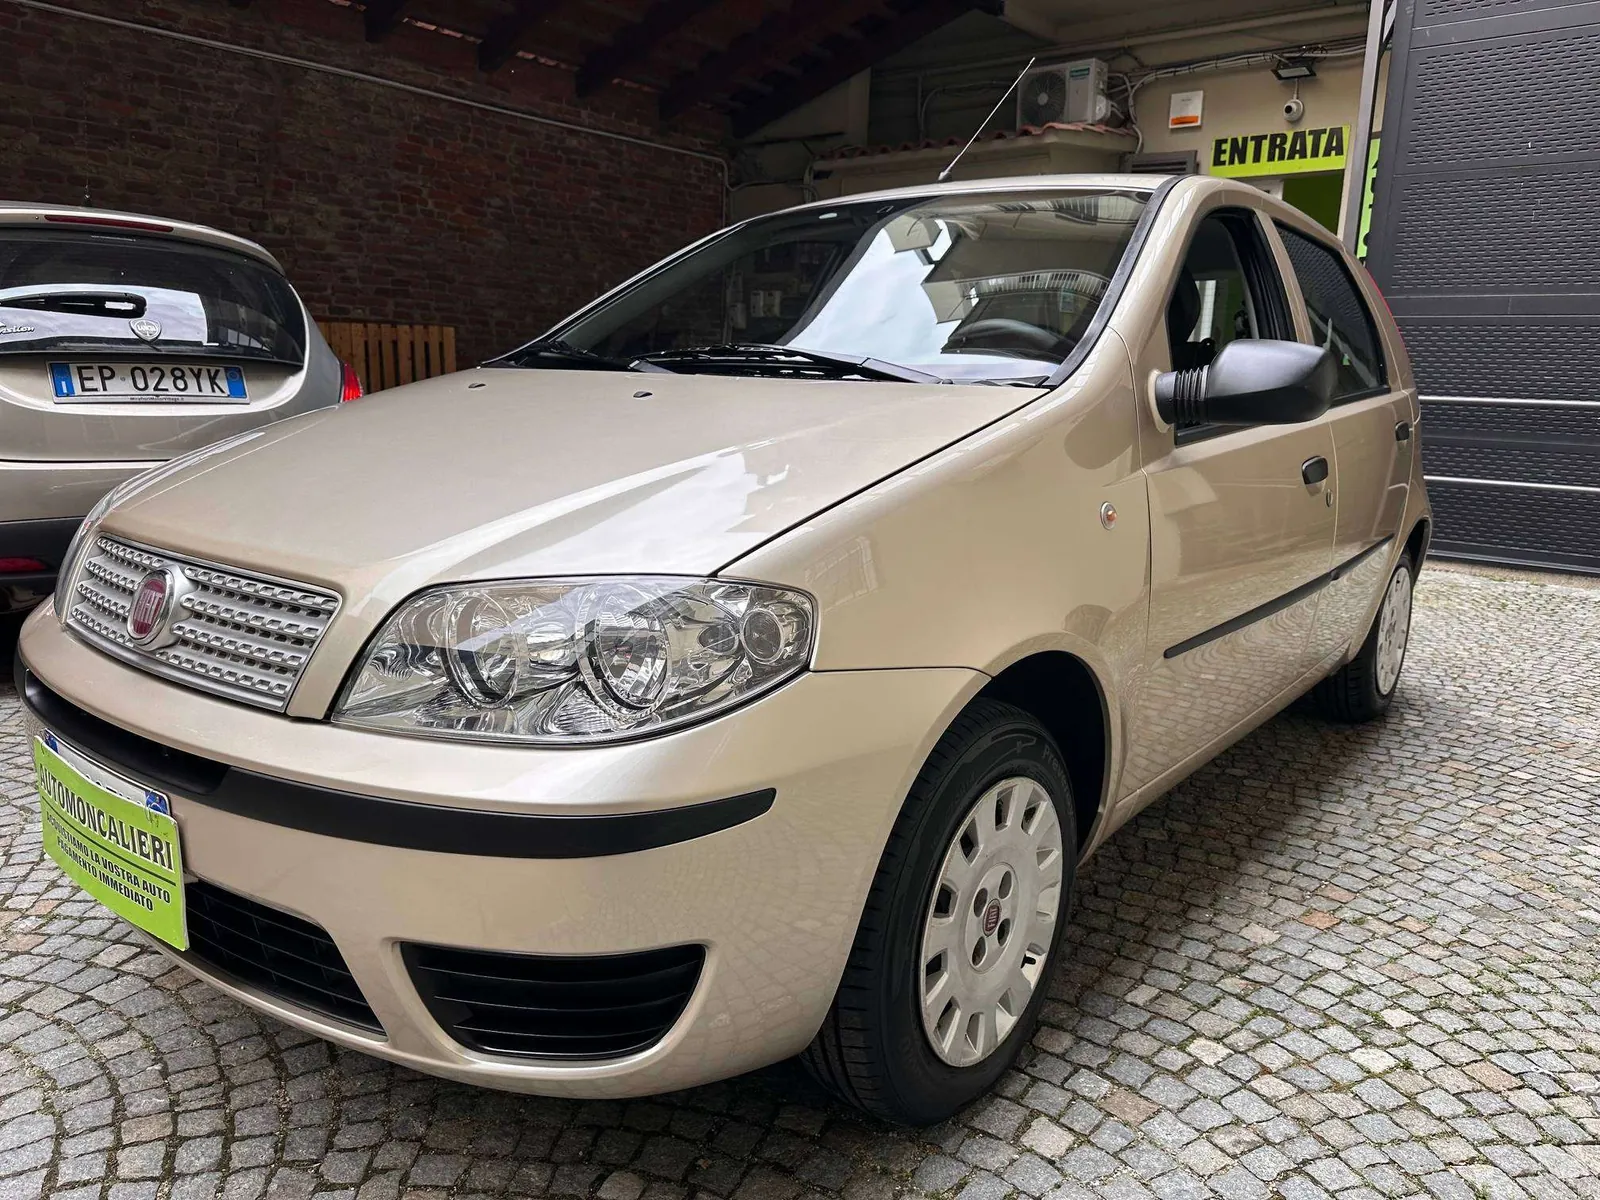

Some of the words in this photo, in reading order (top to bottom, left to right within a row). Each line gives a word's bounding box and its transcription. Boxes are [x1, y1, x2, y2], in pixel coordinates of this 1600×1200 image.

[1212, 126, 1344, 167] ENTRATA
[76, 365, 116, 392] EP
[130, 366, 225, 394] 028YK
[133, 588, 164, 625] FIAT
[40, 762, 174, 872] AUTOMONCALIERI
[46, 811, 89, 857] ACQUISTIAMO
[90, 849, 101, 866] LA
[101, 856, 140, 888] VOSTRA
[142, 879, 171, 904] AUTO
[57, 835, 98, 878] PAGAMENTO
[99, 870, 154, 911] IMMEDIATO
[987, 907, 998, 929] FIAT
